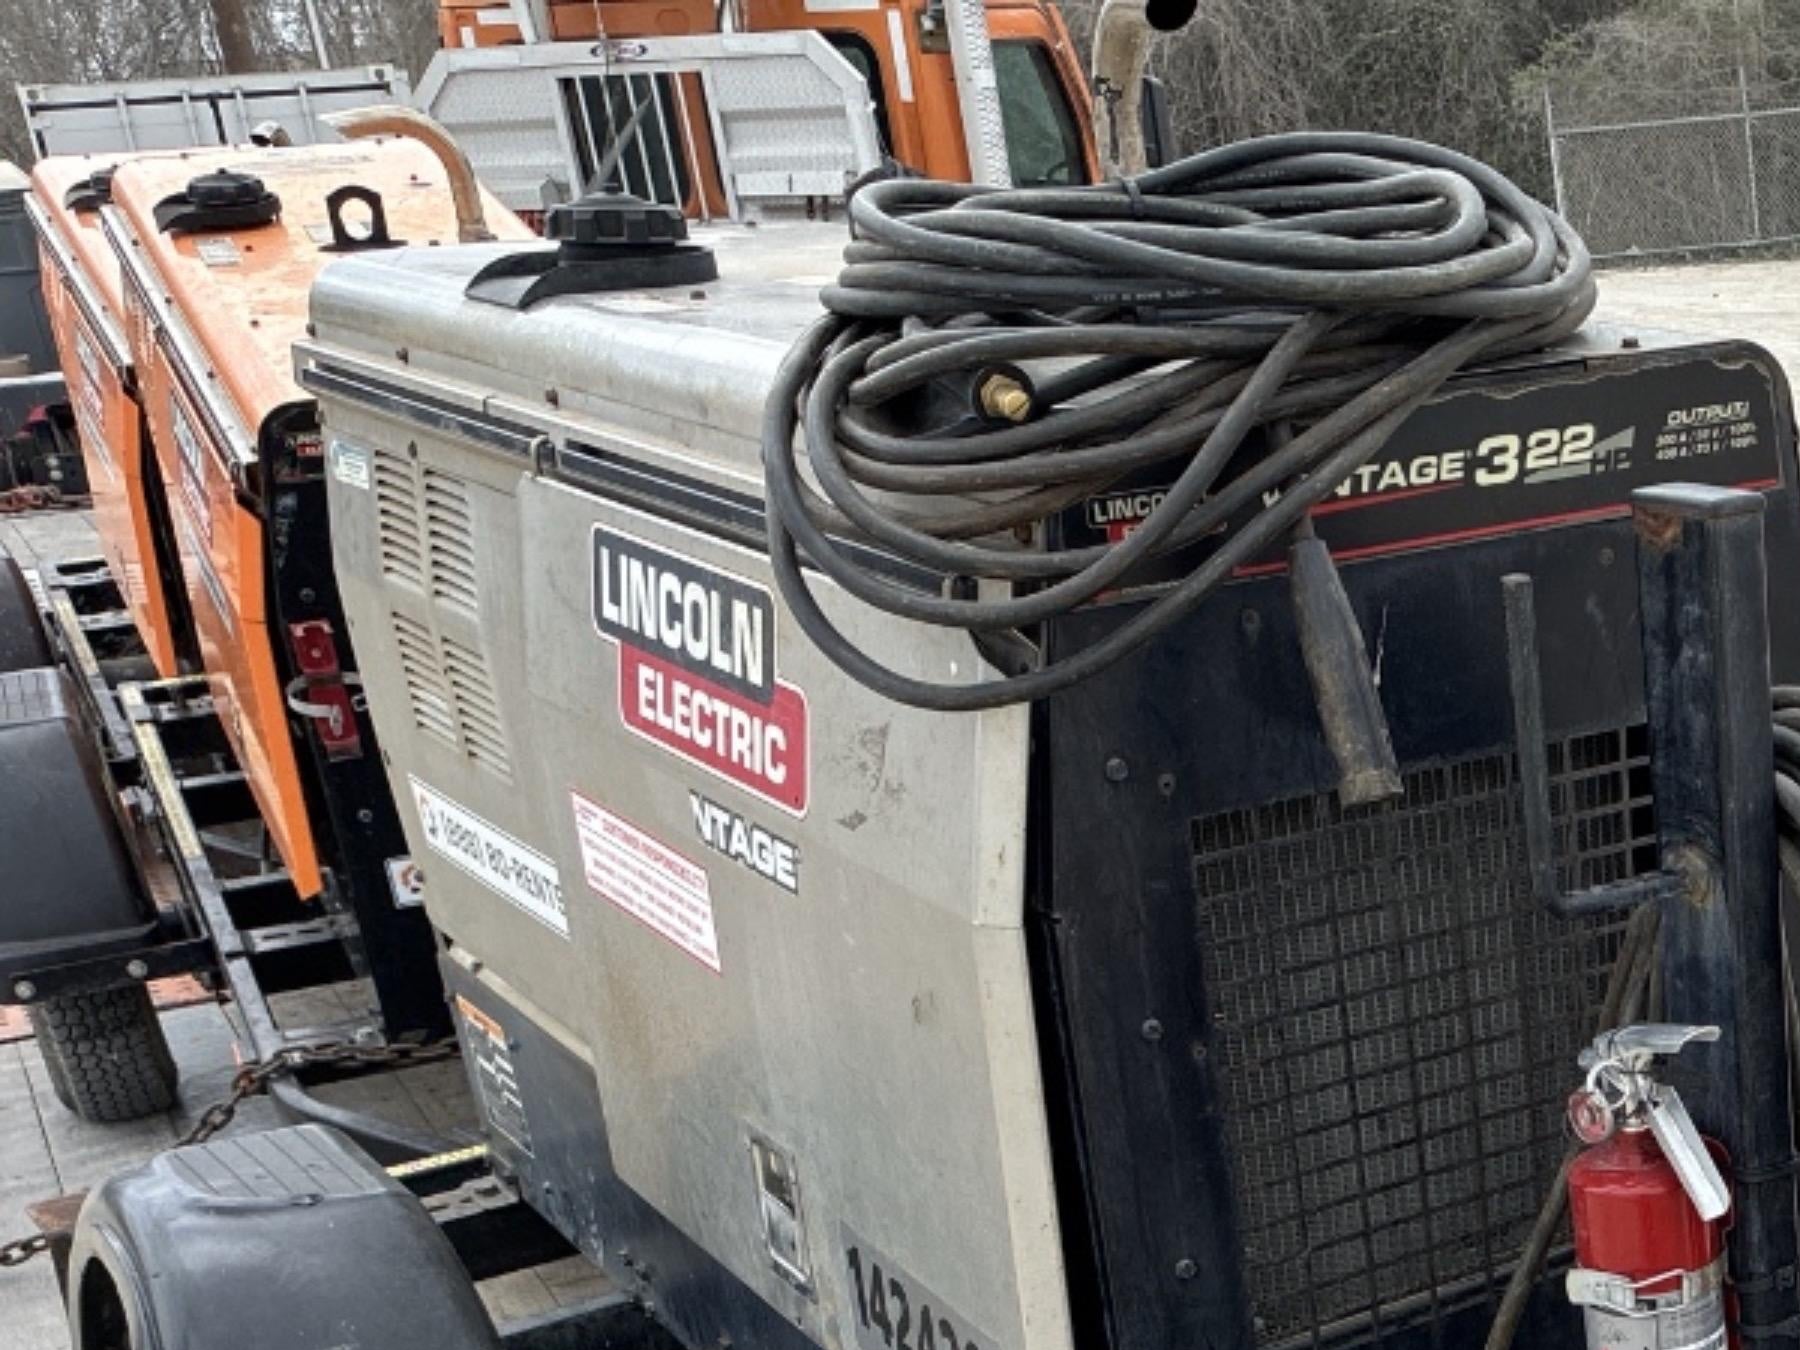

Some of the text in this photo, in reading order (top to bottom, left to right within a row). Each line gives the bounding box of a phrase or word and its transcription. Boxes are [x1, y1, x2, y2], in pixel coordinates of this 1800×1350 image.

[1474, 422, 1596, 487] 322
[600, 544, 764, 688] LINCOLN
[636, 661, 788, 784] ELECTRIC
